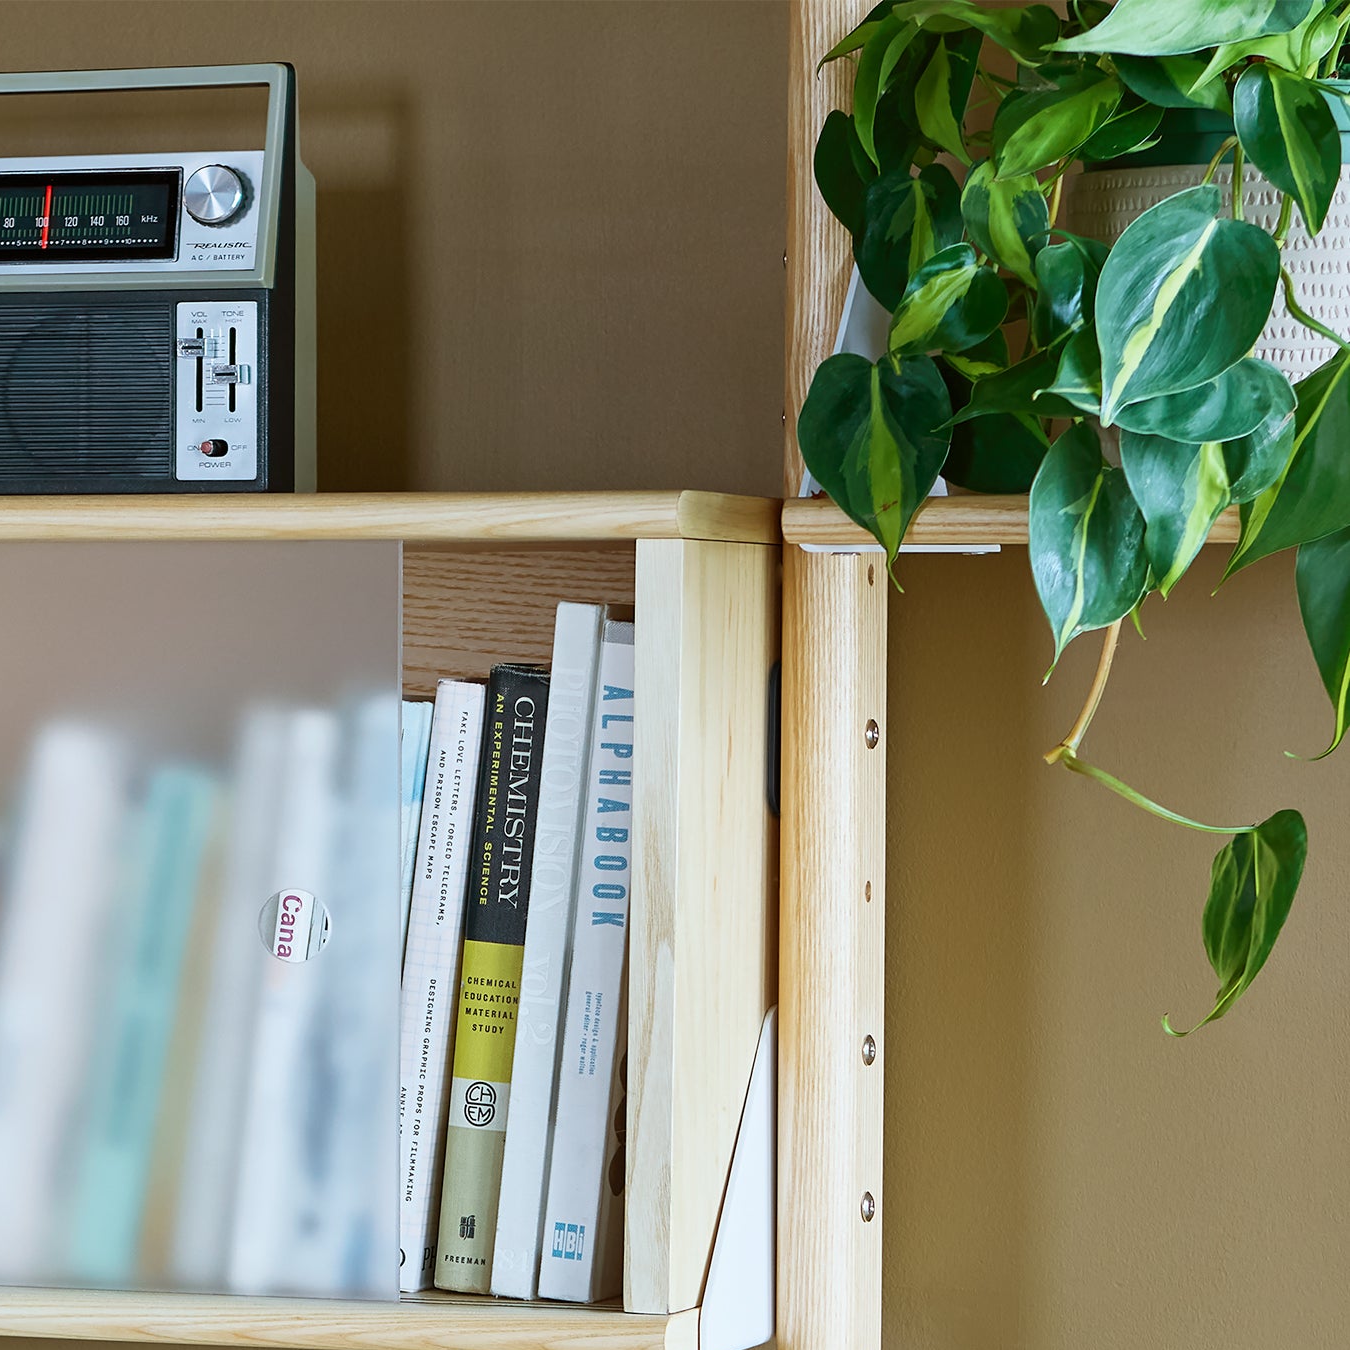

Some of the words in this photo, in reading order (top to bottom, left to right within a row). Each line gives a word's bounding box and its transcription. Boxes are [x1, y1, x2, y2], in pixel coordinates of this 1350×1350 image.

[4, 217, 15, 228] 80
[35, 217, 49, 228] 100
[64, 216, 78, 227] 120
[90, 216, 105, 227] 140
[115, 215, 129, 226] 160
[141, 215, 158, 223] kHz
[496, 693, 505, 713] AN
[459, 711, 469, 734] FAKE
[439, 750, 447, 768] AND
[456, 740, 465, 763] LOVE
[434, 773, 444, 810] PRISON
[486, 721, 503, 833] EXPERIMENTAL
[449, 769, 461, 816] LETTERS,
[498, 696, 536, 909] CHEMISTRY
[591, 684, 634, 927] ALPHABOOK
[428, 815, 439, 850] ESCAPE
[444, 822, 455, 860] FORGED
[425, 855, 434, 879] MAPS
[479, 841, 493, 905] SCIENCE
[436, 865, 451, 926] TELEGRAMS,
[467, 976, 517, 989] CHEMICAL
[424, 979, 437, 1033] DESIGNING
[464, 991, 519, 1005] EDUCATION
[465, 1007, 515, 1020] MATERIAL
[471, 1023, 504, 1034] STUDY
[419, 1038, 430, 1080] GRAPHIC
[415, 1084, 425, 1114] PROPS
[413, 1119, 421, 1136] FOR
[405, 1141, 418, 1202] FILMMAKING
[444, 1254, 486, 1266] FREEMAN
